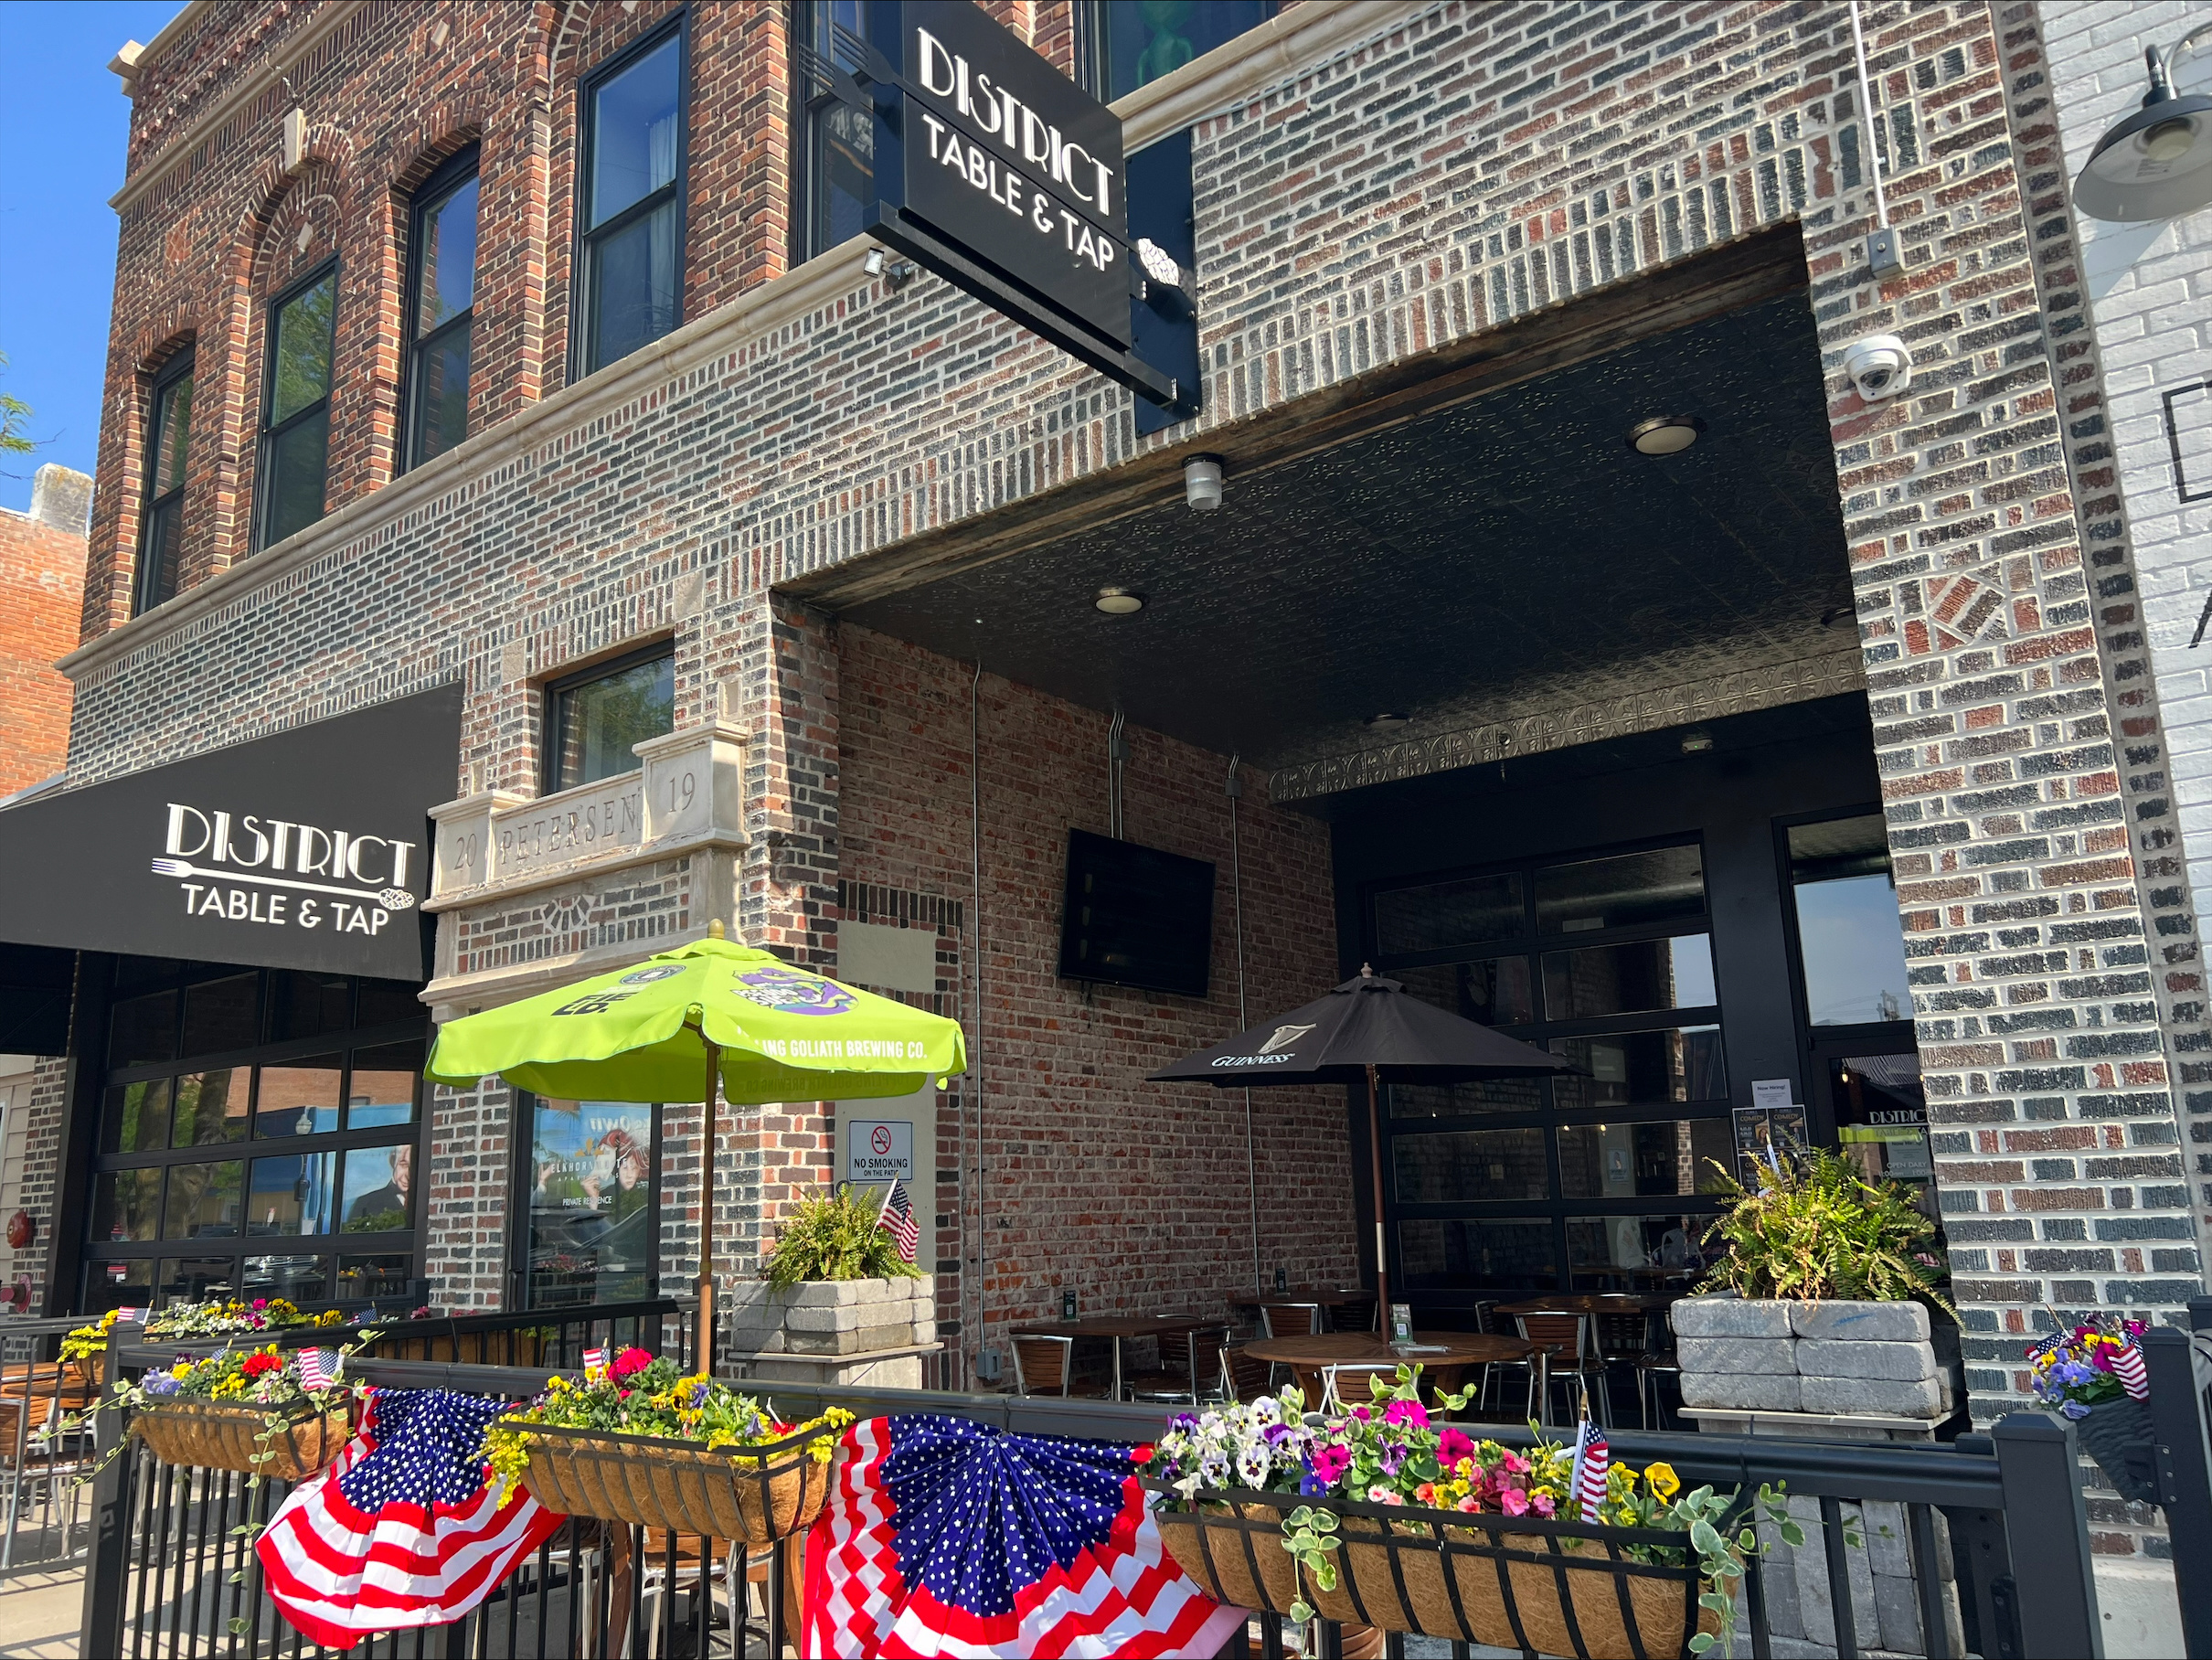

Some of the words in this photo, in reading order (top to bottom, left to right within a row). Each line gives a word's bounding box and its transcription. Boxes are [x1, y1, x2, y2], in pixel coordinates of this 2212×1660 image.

[917, 26, 1114, 217] DISTRICT
[922, 113, 1024, 217] TABLE
[1033, 193, 1054, 233] &
[1060, 208, 1114, 271] TAP
[453, 833, 477, 870] 20
[501, 787, 643, 866] PETERSEN
[668, 771, 696, 813] 19
[166, 803, 416, 888] DISTRICT
[181, 882, 288, 925] TABLE
[298, 899, 322, 929] &
[330, 901, 389, 936] TAP
[790, 1038, 843, 1059] GOLIATH
[846, 1039, 904, 1059] BREWING
[907, 1040, 929, 1059] CO.
[1211, 1052, 1296, 1068] GUINNESS
[1739, 1114, 1764, 1123] COMEDY
[1773, 1112, 1798, 1121] COMEDY
[1868, 1109, 1927, 1124] DISTRIC
[854, 1158, 867, 1168] NO
[868, 1158, 908, 1168] SMOKING
[562, 1197, 582, 1207] PRIVATE
